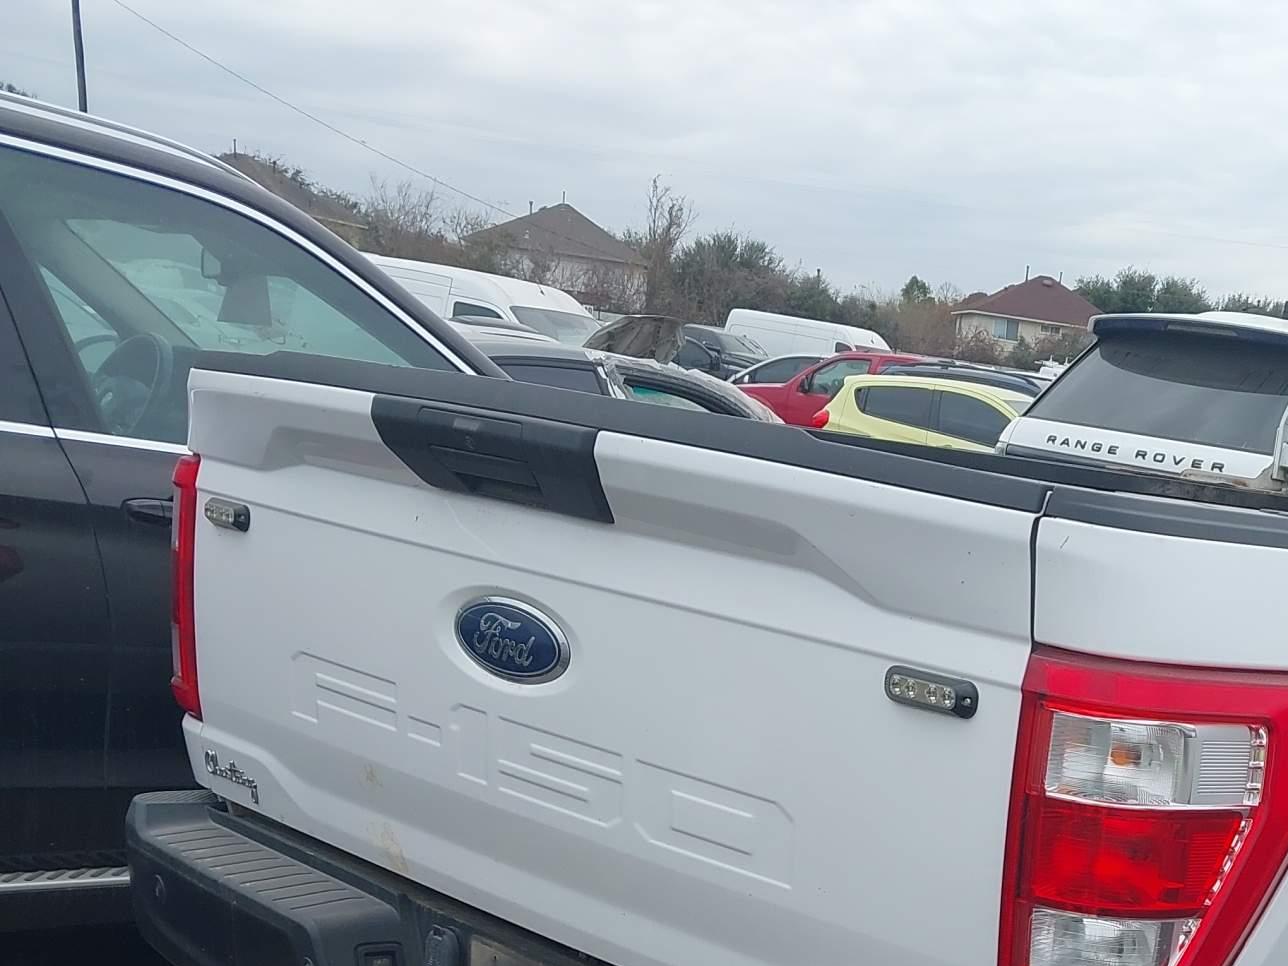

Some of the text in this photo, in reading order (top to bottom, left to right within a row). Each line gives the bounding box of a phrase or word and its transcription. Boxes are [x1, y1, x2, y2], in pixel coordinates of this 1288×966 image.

[1046, 434, 1225, 473] RANGE ROVER
[473, 612, 536, 667] Ford
[291, 650, 796, 889] F-150
